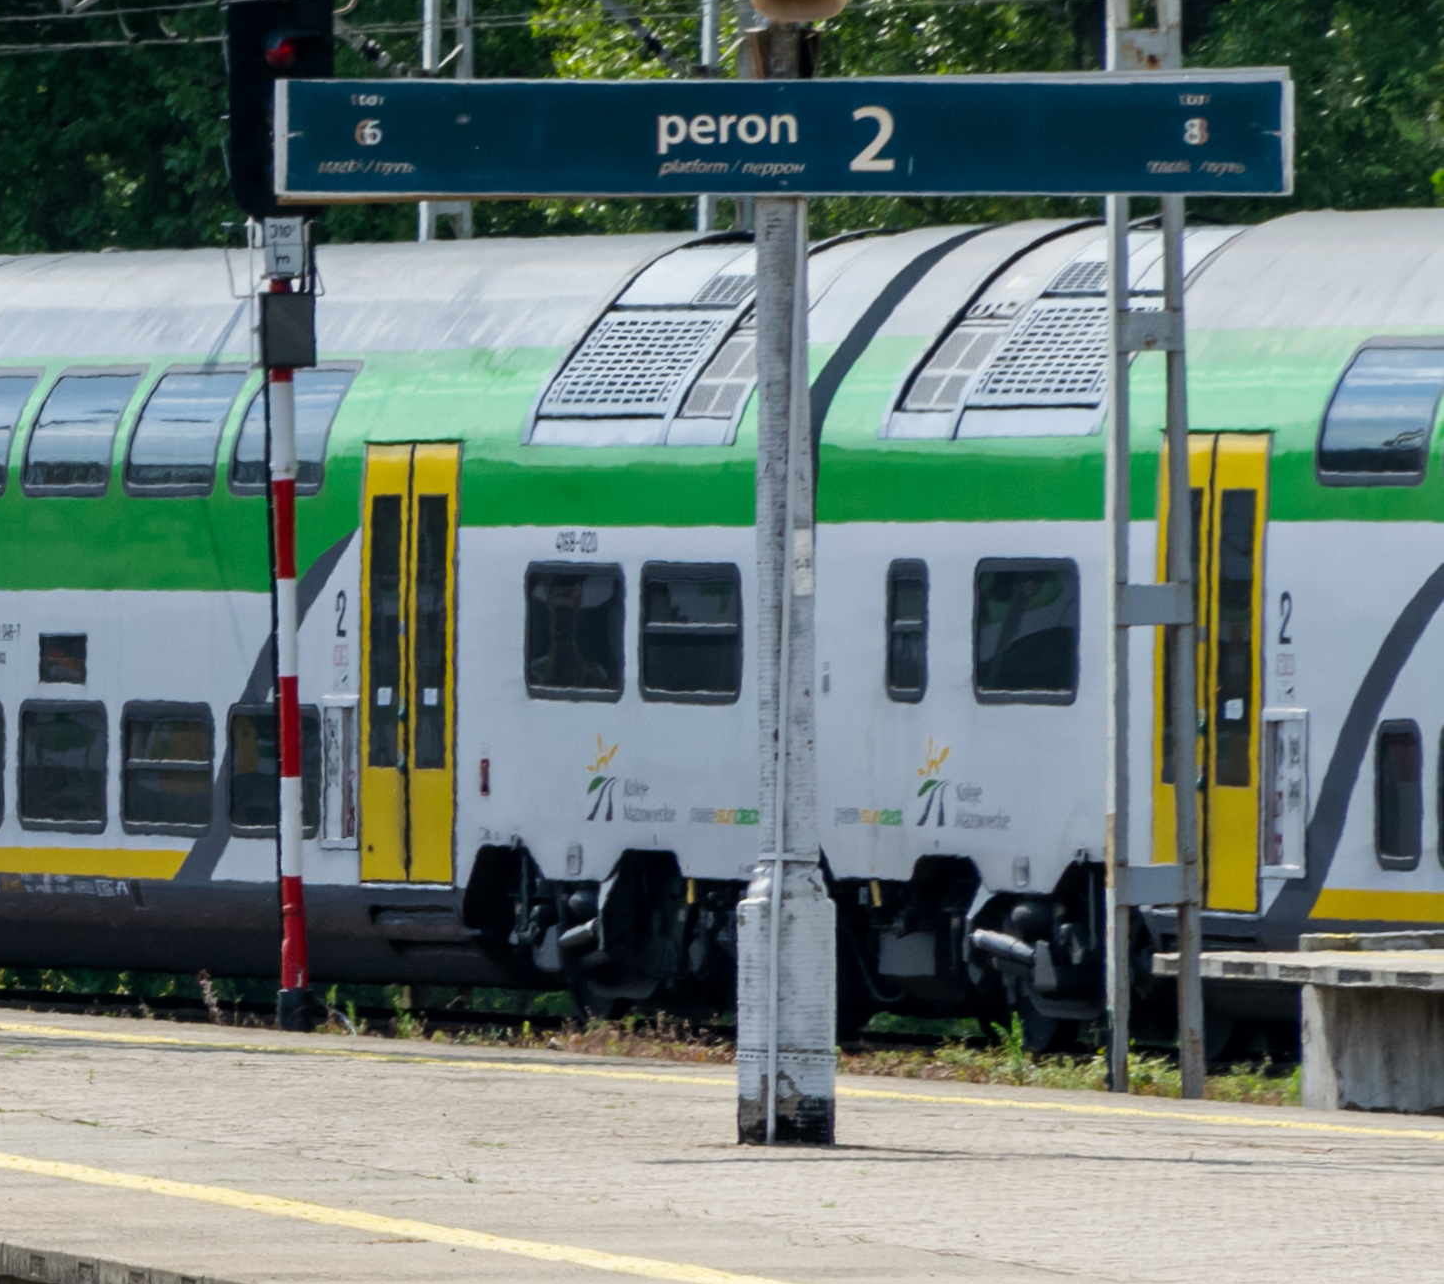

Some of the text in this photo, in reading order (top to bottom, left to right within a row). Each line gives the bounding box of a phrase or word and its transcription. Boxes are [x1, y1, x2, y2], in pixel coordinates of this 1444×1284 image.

[355, 119, 382, 146] 6
[657, 105, 896, 172] peron 2
[1183, 117, 1209, 146] 8
[658, 158, 730, 177] platform
[741, 161, 806, 177] перрон
[335, 589, 347, 637] 2
[1279, 591, 1293, 644] 2
